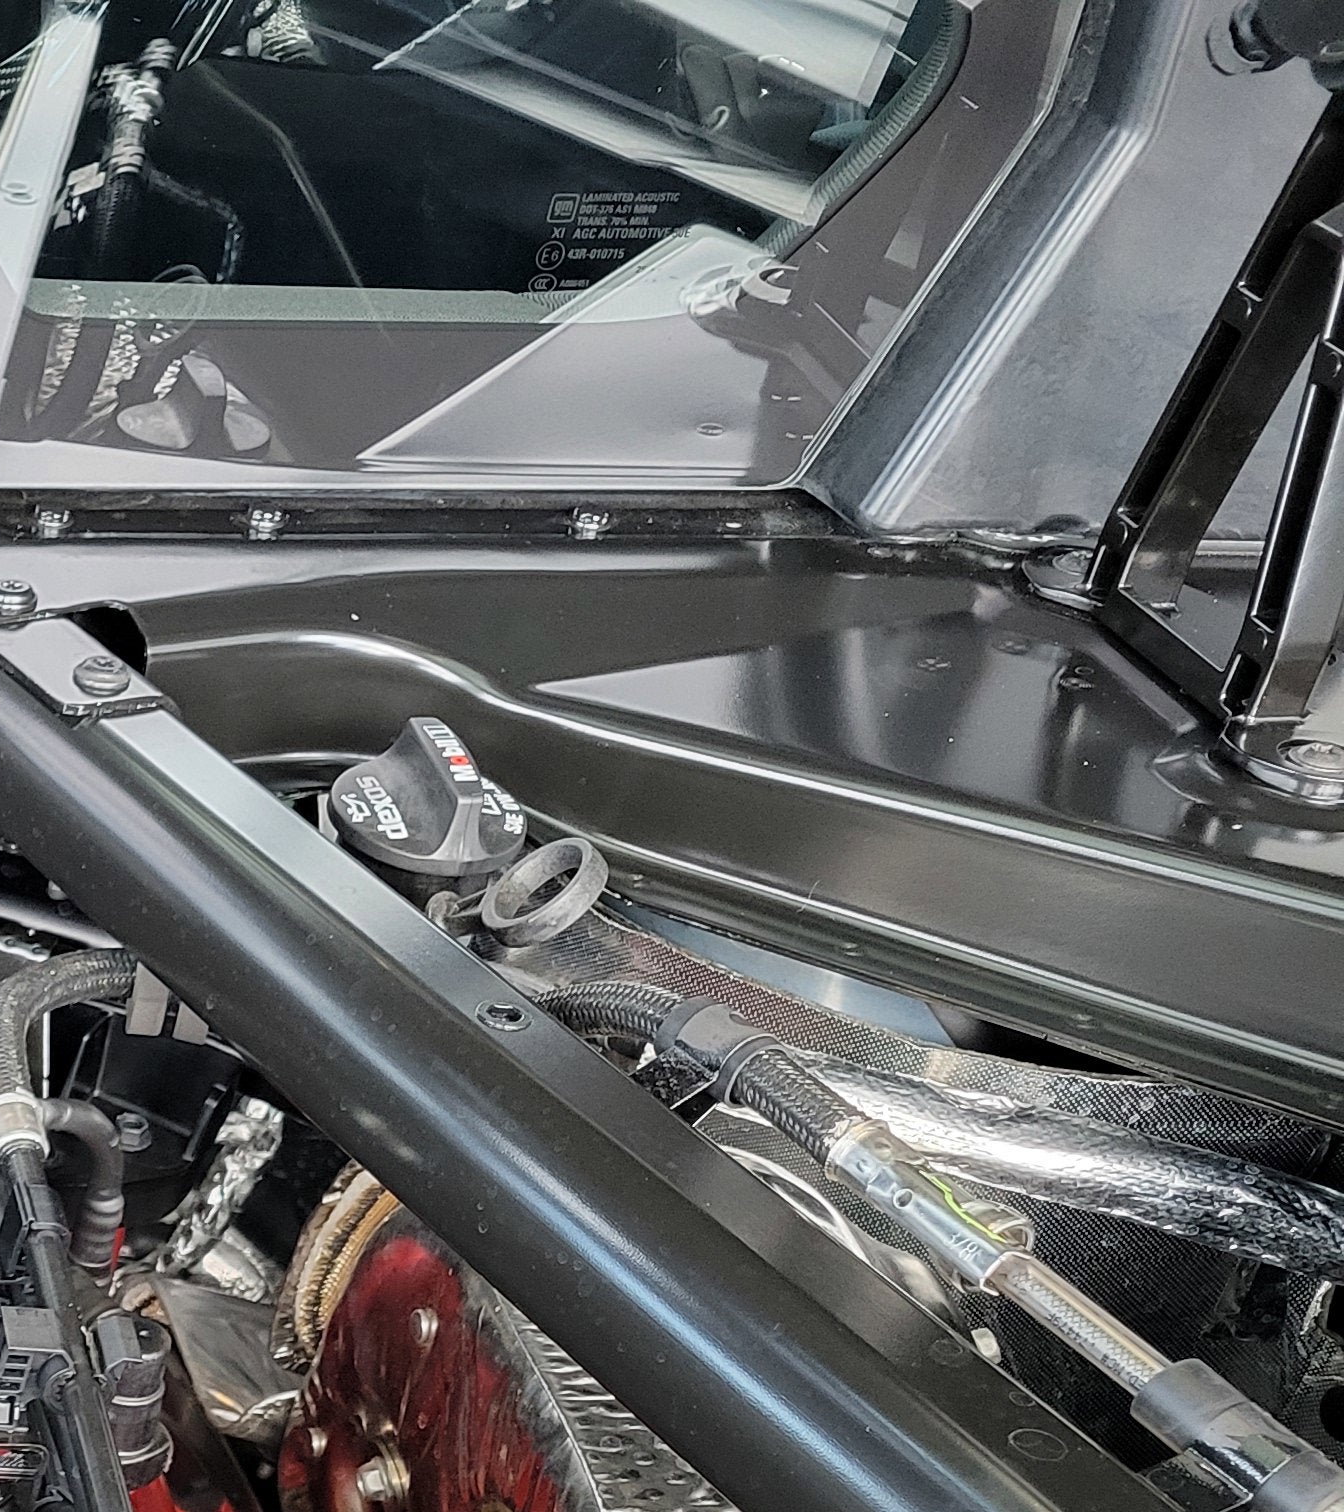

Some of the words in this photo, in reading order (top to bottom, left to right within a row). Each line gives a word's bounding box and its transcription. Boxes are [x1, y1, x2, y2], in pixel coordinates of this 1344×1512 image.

[581, 192, 634, 203] LAMINATED
[634, 192, 681, 203] ACOUSTIC
[572, 227, 597, 239] AGC
[598, 227, 671, 239] AUTOMOTIVE
[435, 739, 480, 782] Mobil
[356, 775, 409, 841] dexos
